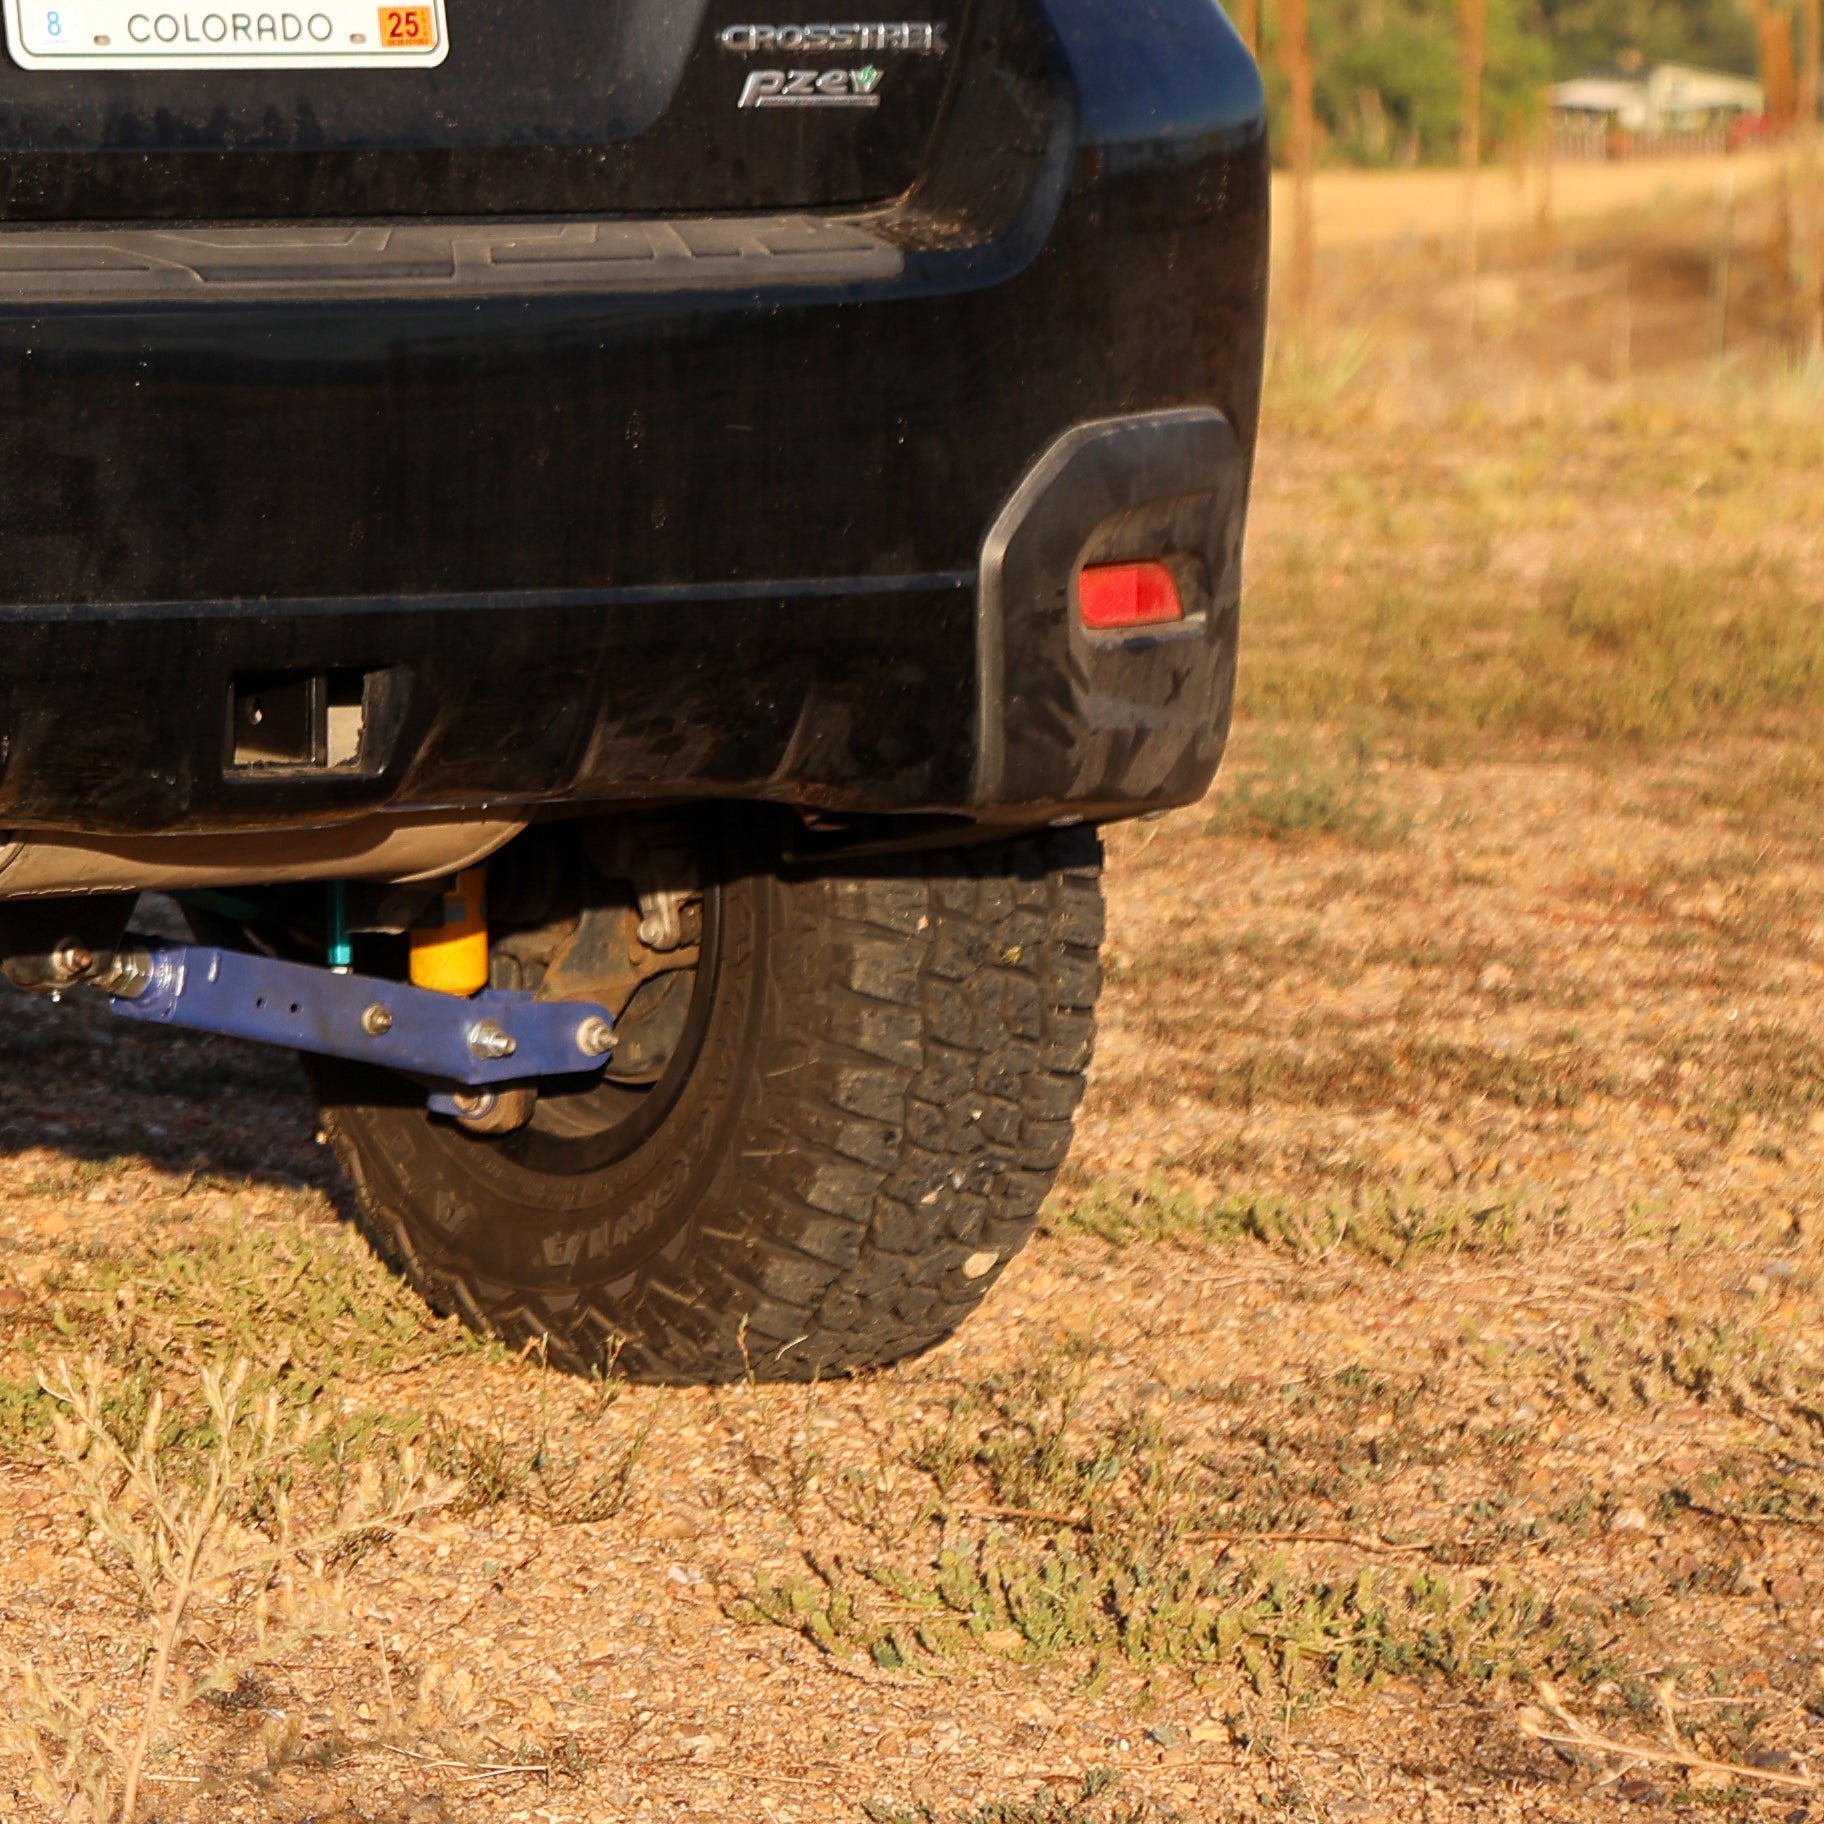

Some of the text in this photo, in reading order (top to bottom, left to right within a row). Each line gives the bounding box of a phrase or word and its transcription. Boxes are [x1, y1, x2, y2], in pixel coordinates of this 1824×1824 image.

[46, 10, 62, 36] 8
[126, 12, 334, 44] COLORADO
[387, 11, 420, 37] 25
